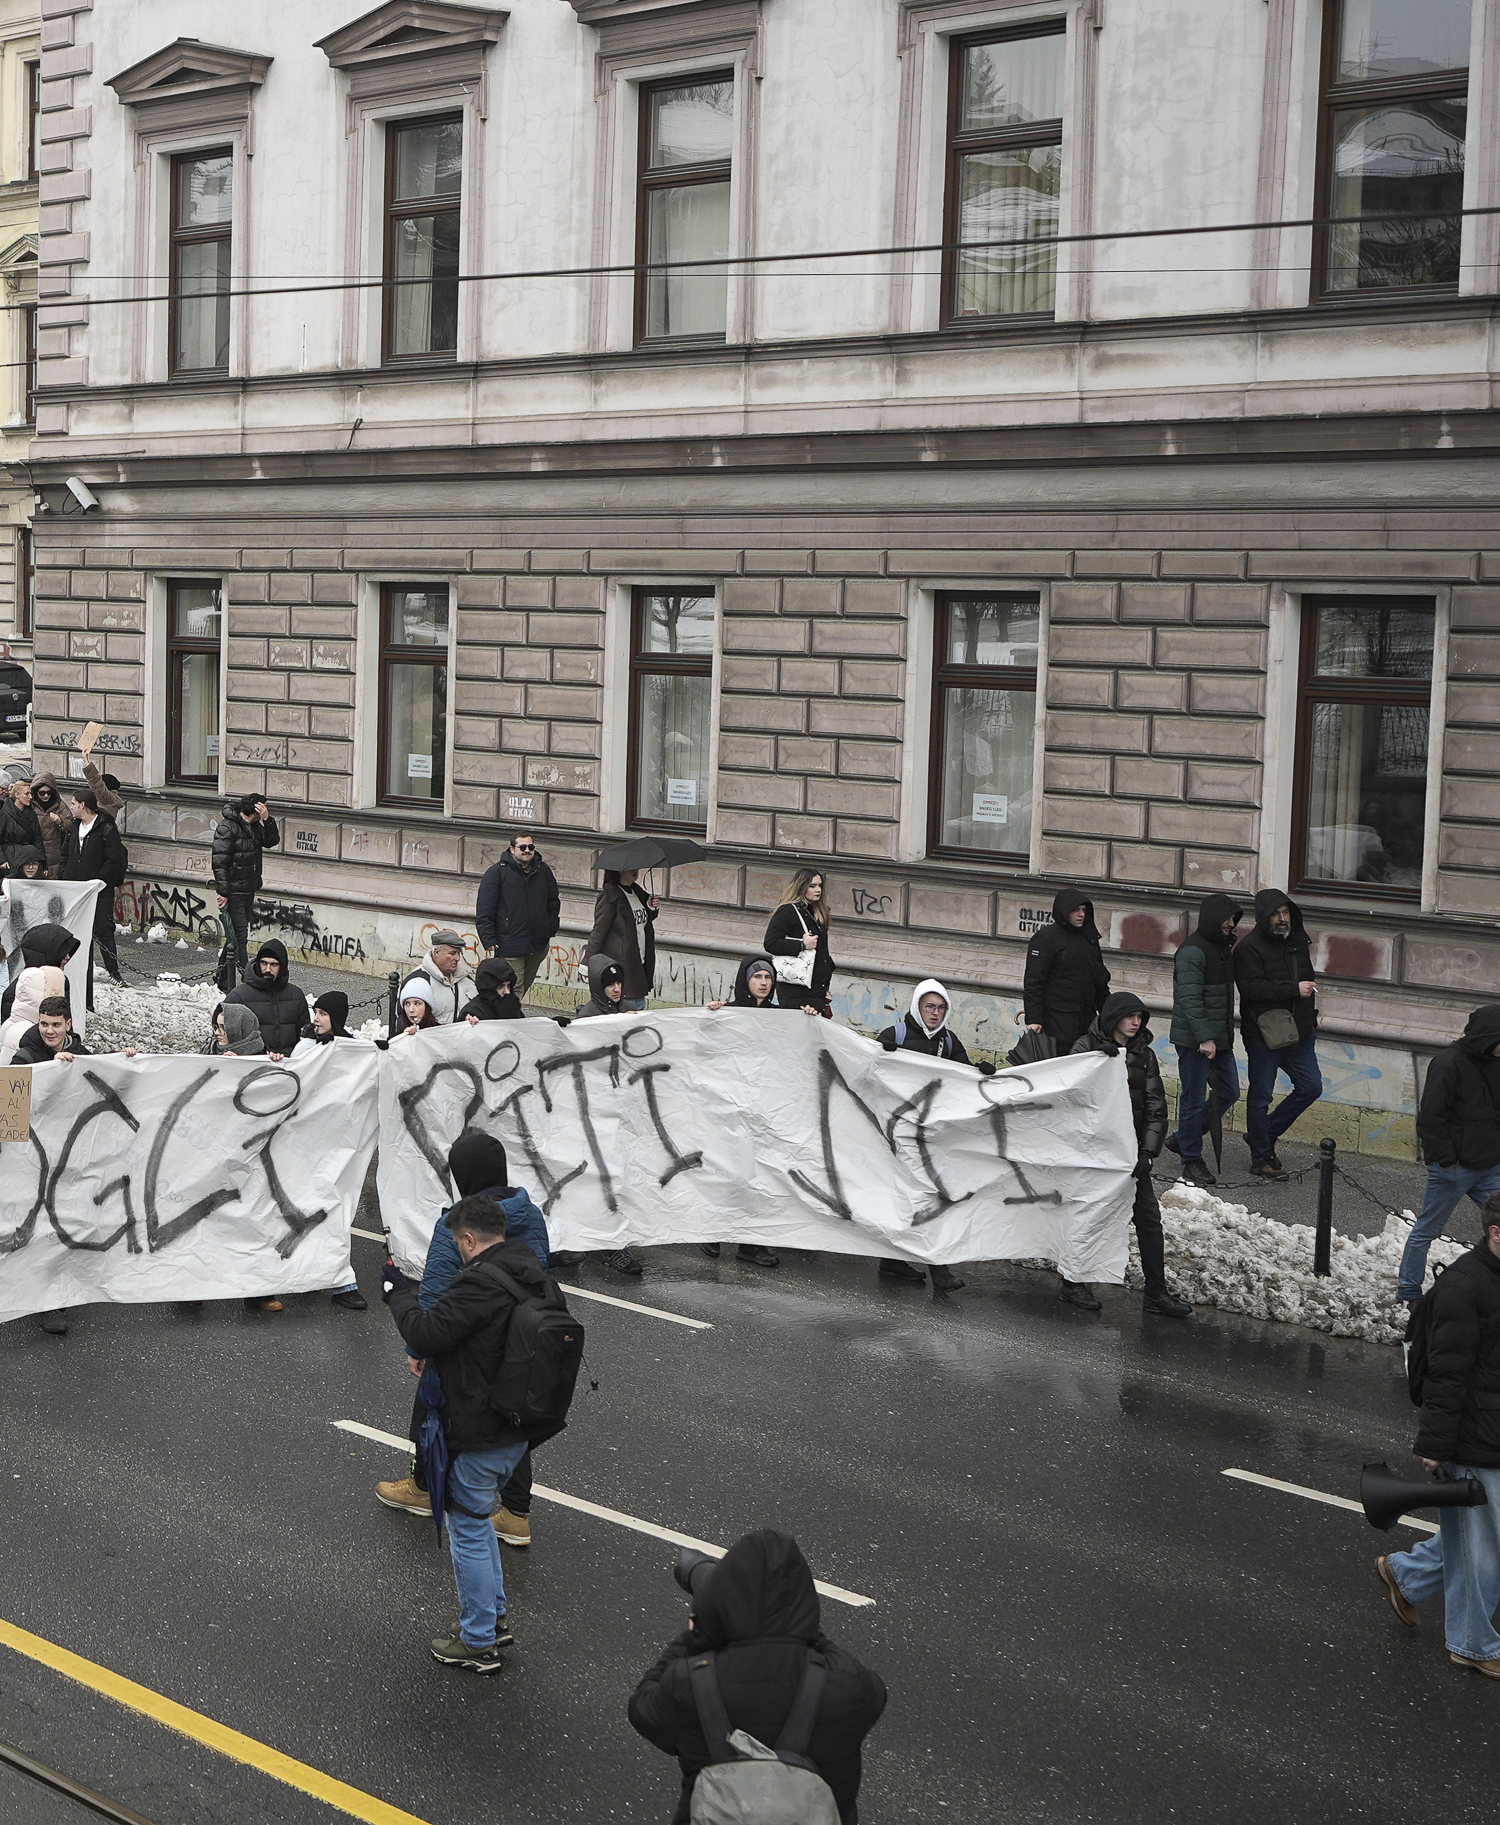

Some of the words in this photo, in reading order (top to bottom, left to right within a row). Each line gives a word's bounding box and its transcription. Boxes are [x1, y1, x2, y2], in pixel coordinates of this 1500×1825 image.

[508, 796, 534, 809] 01.07.
[508, 808, 533, 818] OTKAZ
[296, 831, 319, 844] 01.07.
[1020, 908, 1054, 923] 01.07.
[9, 1078, 31, 1096] VAM
